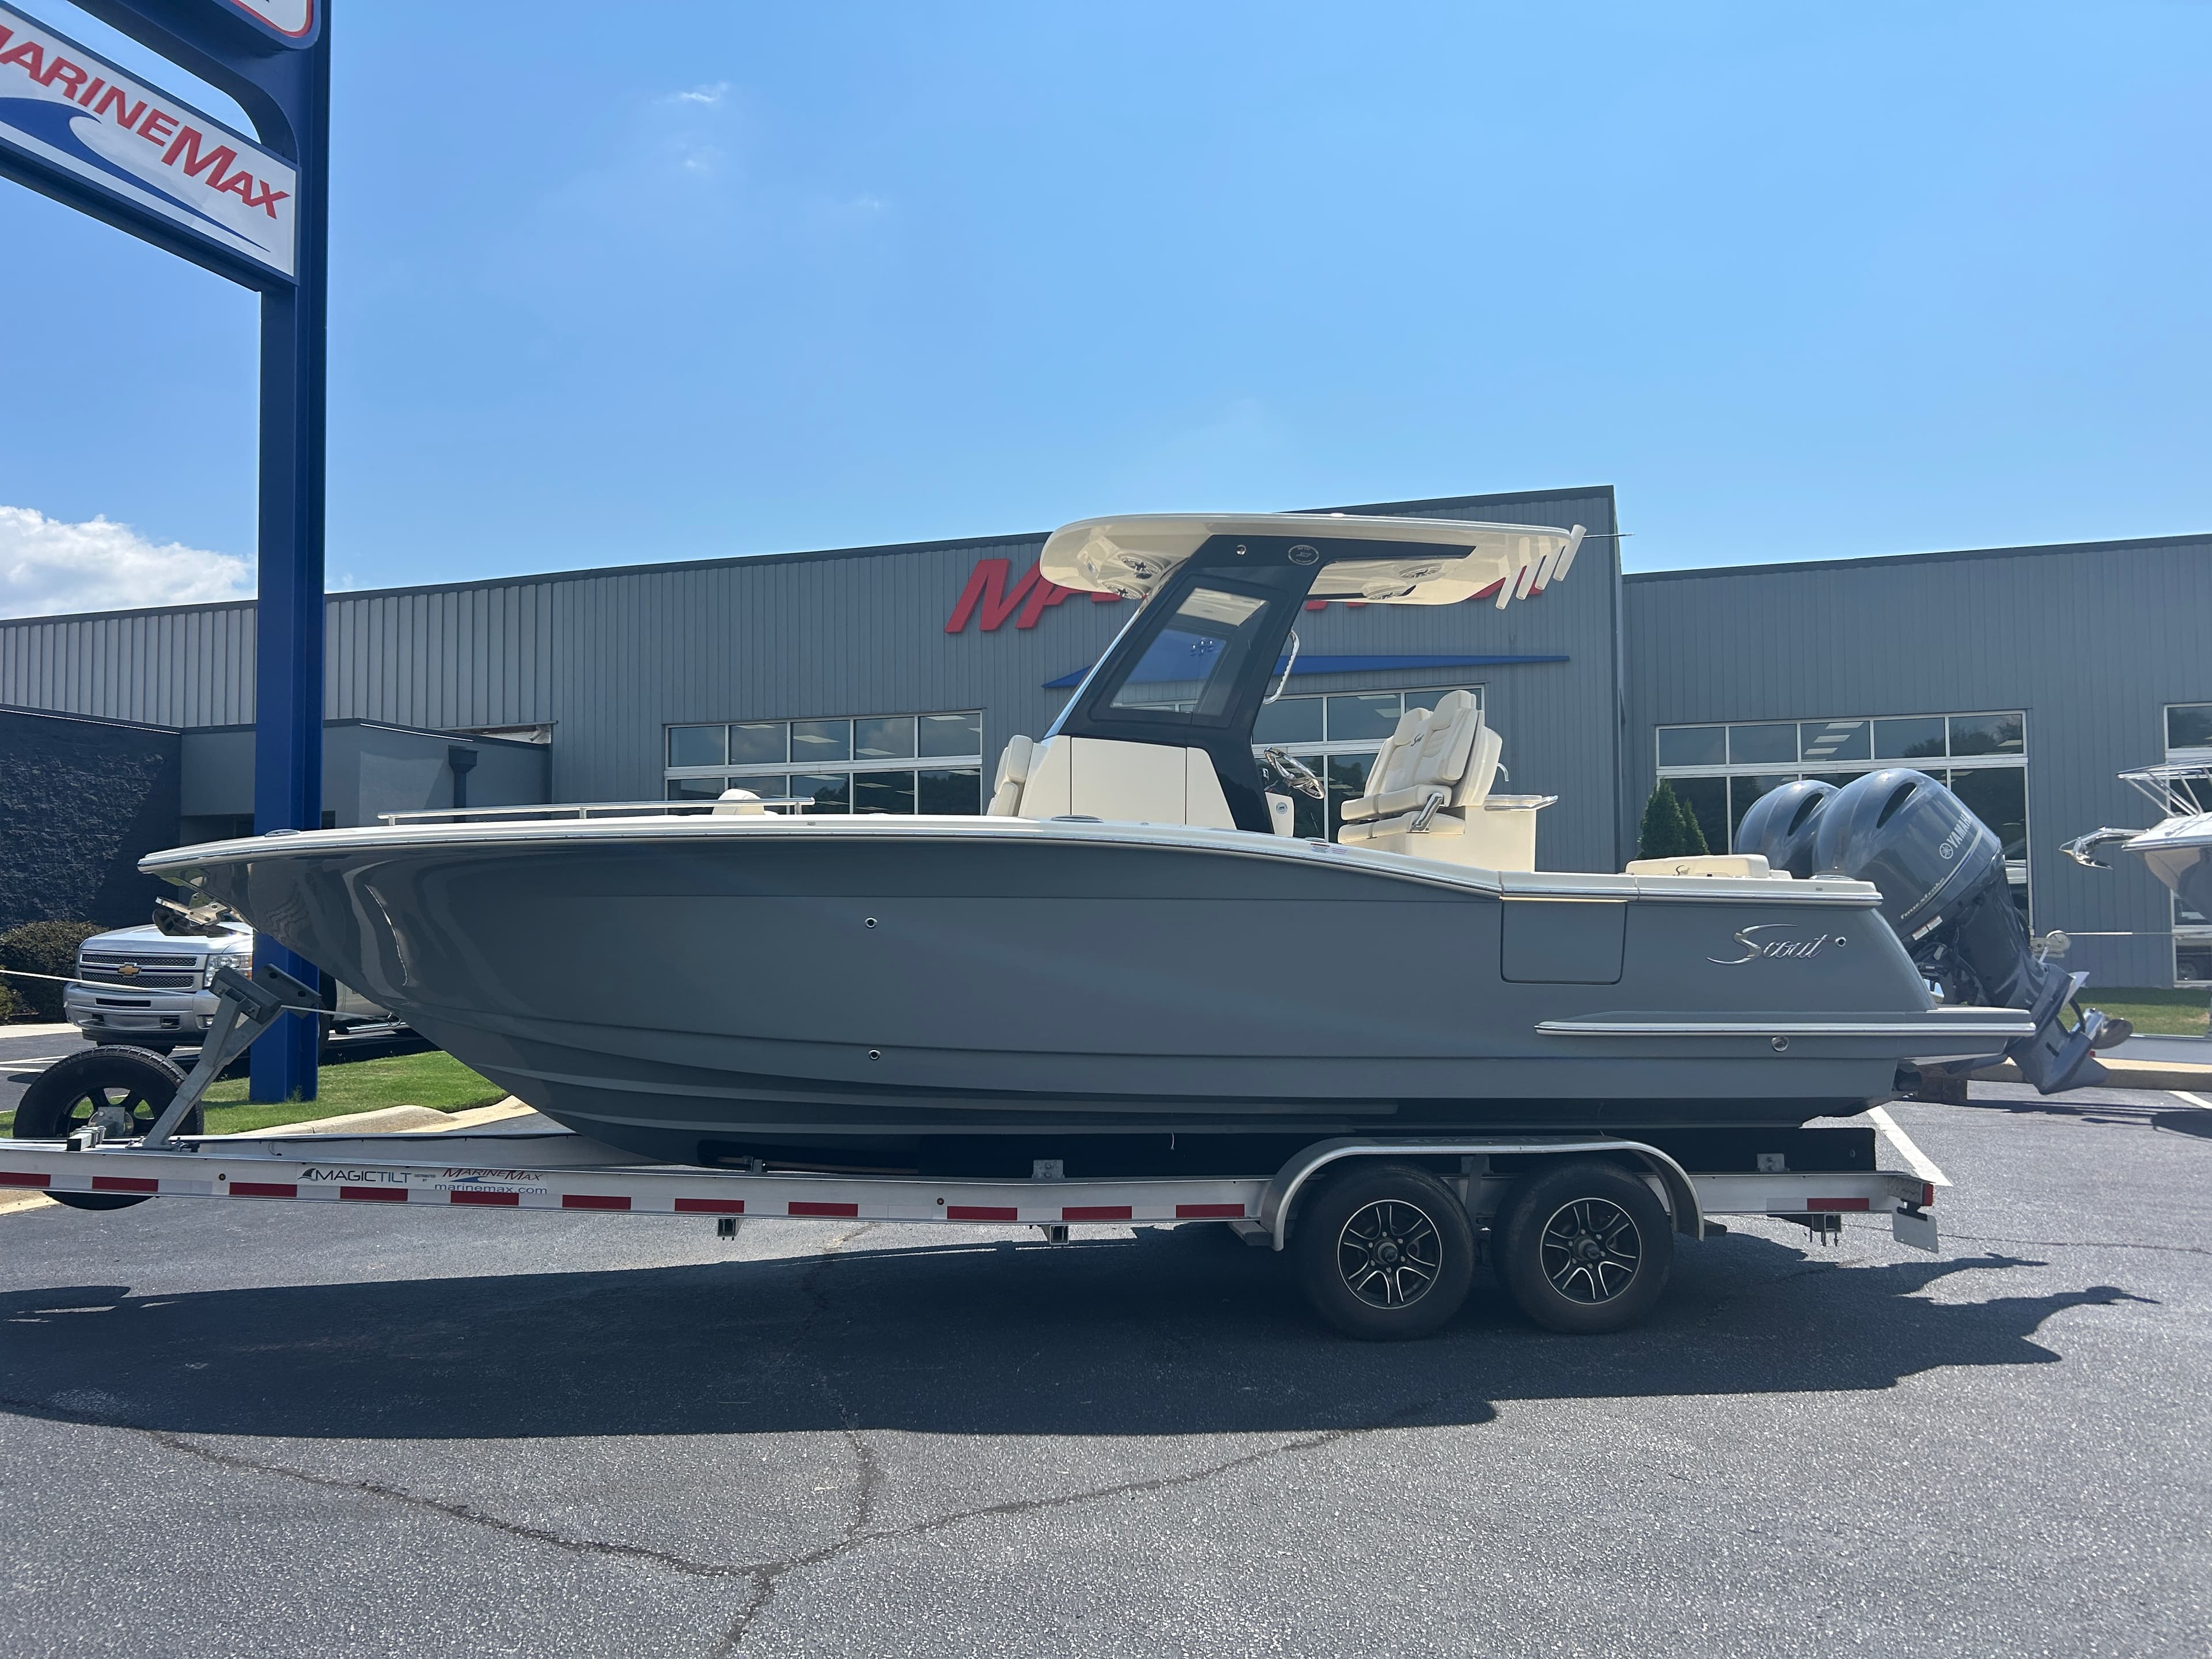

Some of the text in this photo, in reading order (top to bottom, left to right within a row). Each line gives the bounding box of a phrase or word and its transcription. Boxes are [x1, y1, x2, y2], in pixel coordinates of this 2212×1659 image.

[0, 25, 290, 220] ARINEMAX
[1946, 810, 1971, 848] YAMAHA
[1707, 923, 1828, 965] Scout
[316, 1170, 412, 1183] MAGICTILT
[435, 1184, 547, 1194] marinemax.com
